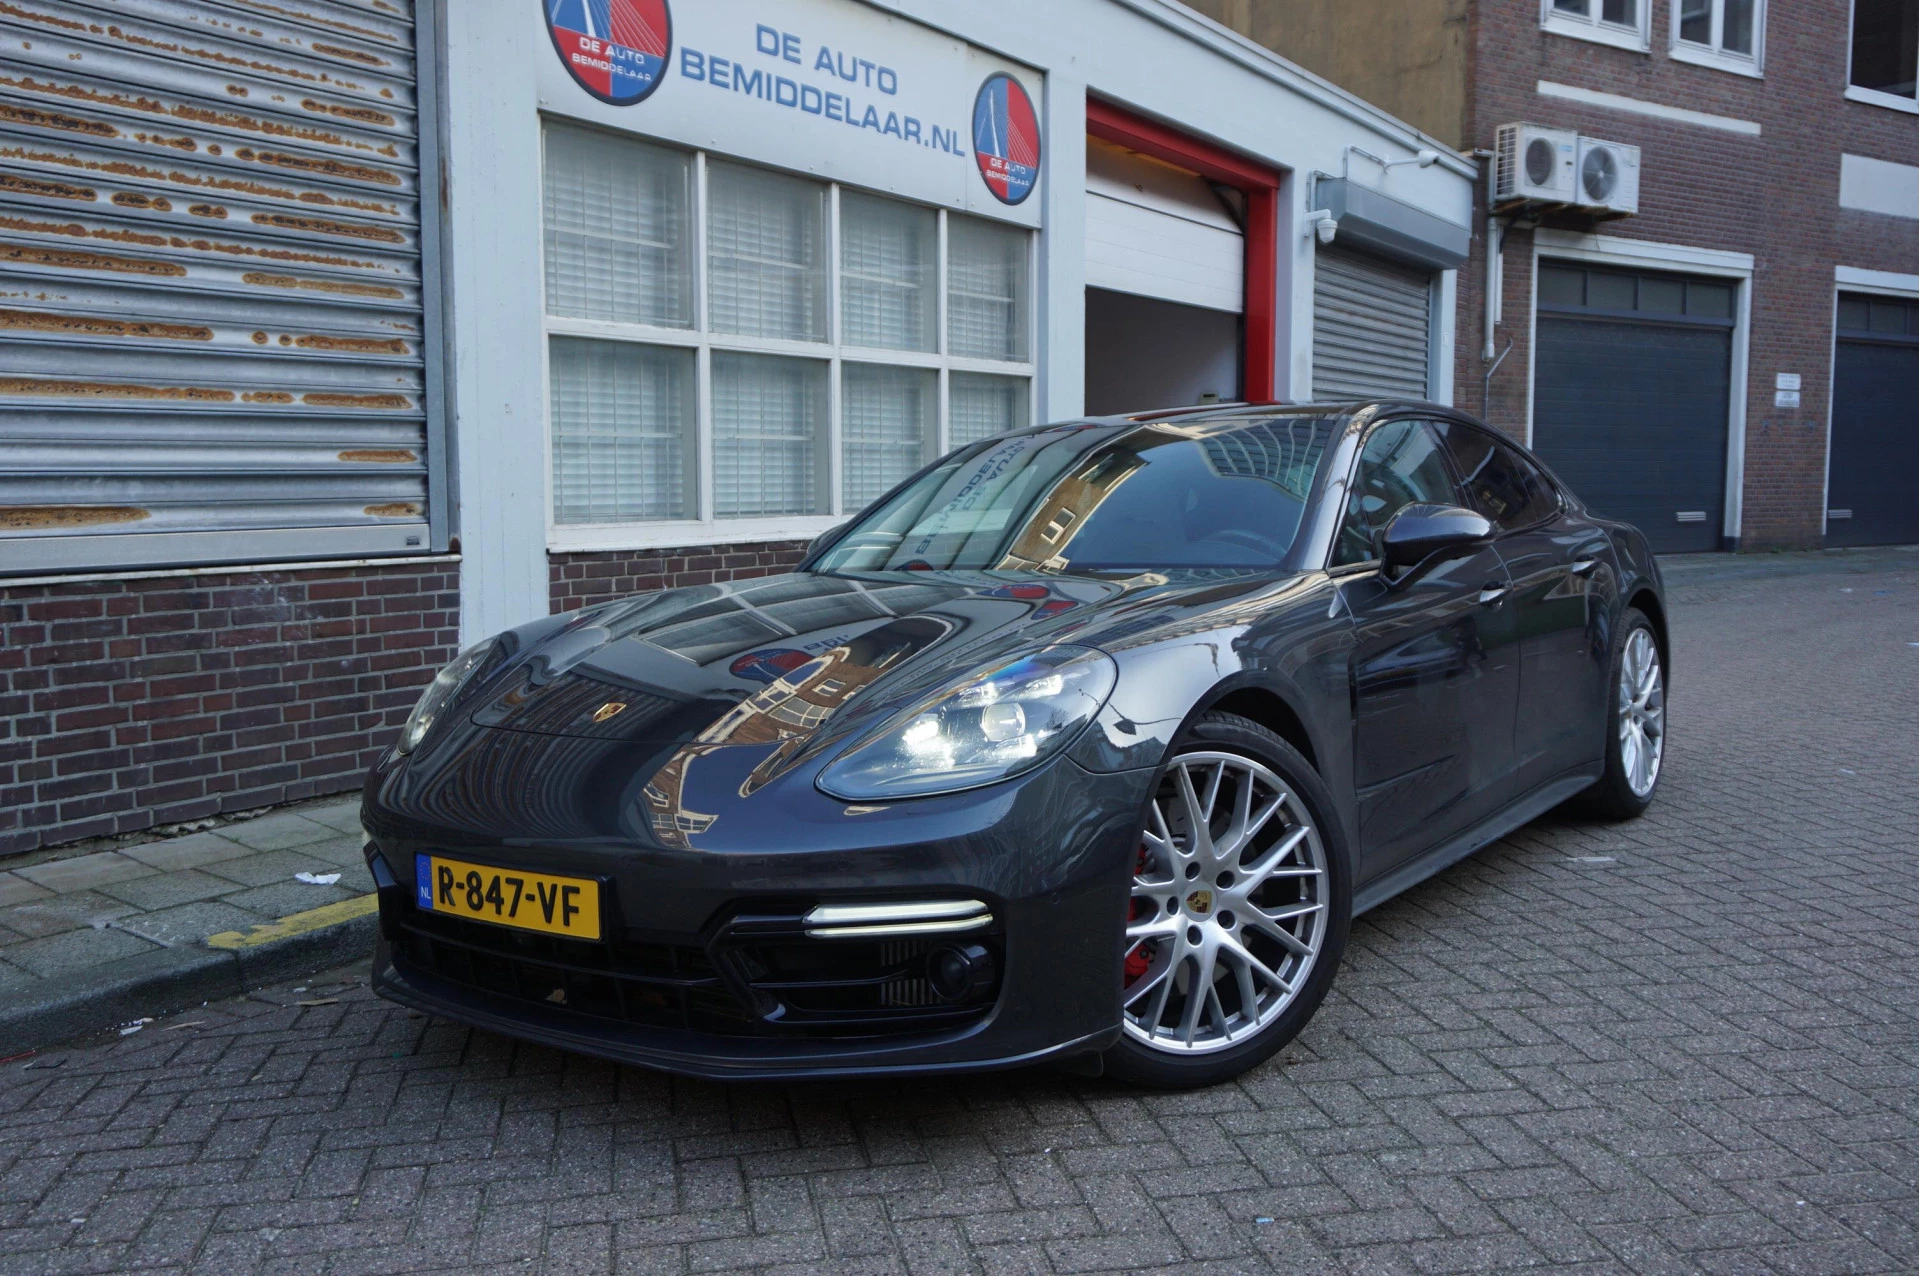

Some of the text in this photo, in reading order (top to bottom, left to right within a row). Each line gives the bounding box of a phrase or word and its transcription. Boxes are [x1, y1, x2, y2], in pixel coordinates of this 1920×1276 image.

[579, 36, 645, 64] DE AUTO
[756, 23, 897, 96] DE AUTO
[571, 52, 651, 81] BEMIDDELAAR
[680, 46, 965, 157] BEMIDDELAAR.NL
[986, 169, 1030, 186] BEMIDDELAAR
[990, 157, 1026, 175] DE AUTO
[420, 886, 432, 900] NL
[438, 865, 581, 927] R-847-VF
